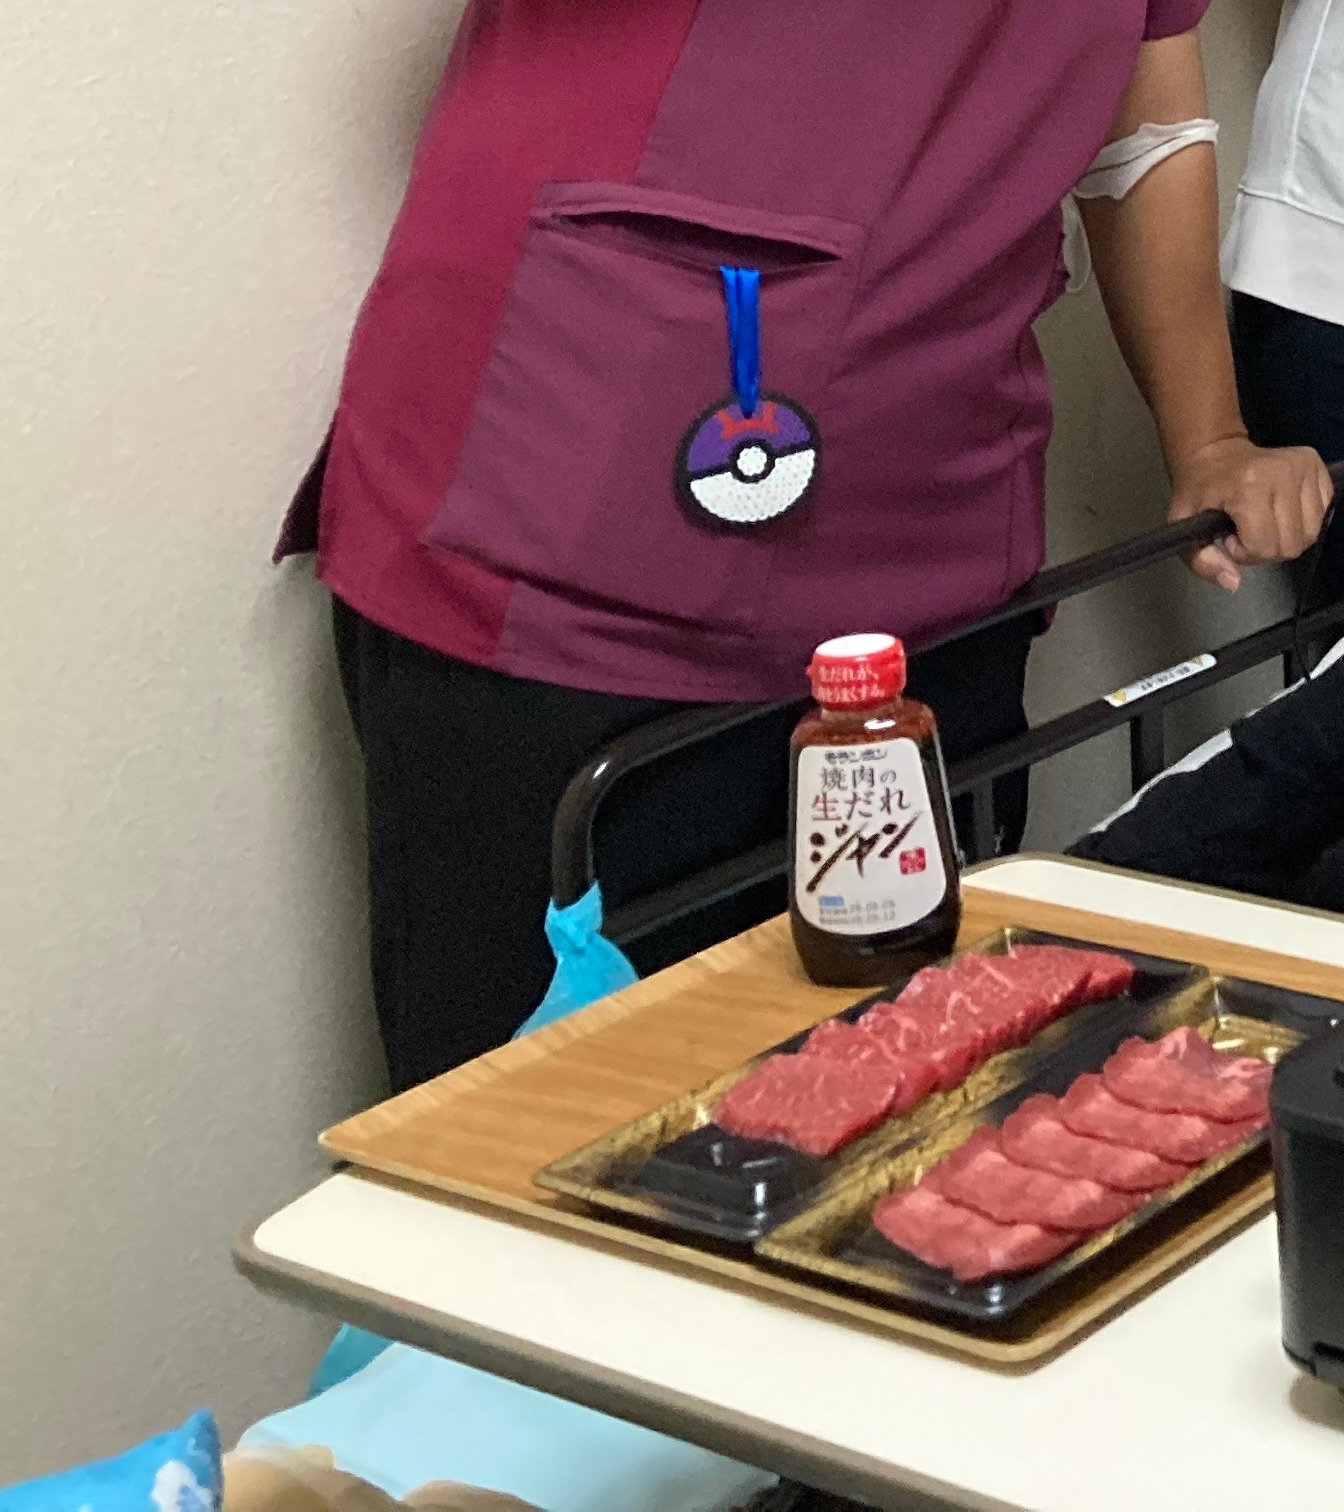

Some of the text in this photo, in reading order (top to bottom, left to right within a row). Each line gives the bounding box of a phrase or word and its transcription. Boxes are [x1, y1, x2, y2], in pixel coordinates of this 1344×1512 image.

[811, 787, 911, 822] 生だれ
[805, 810, 926, 894] ジャン
